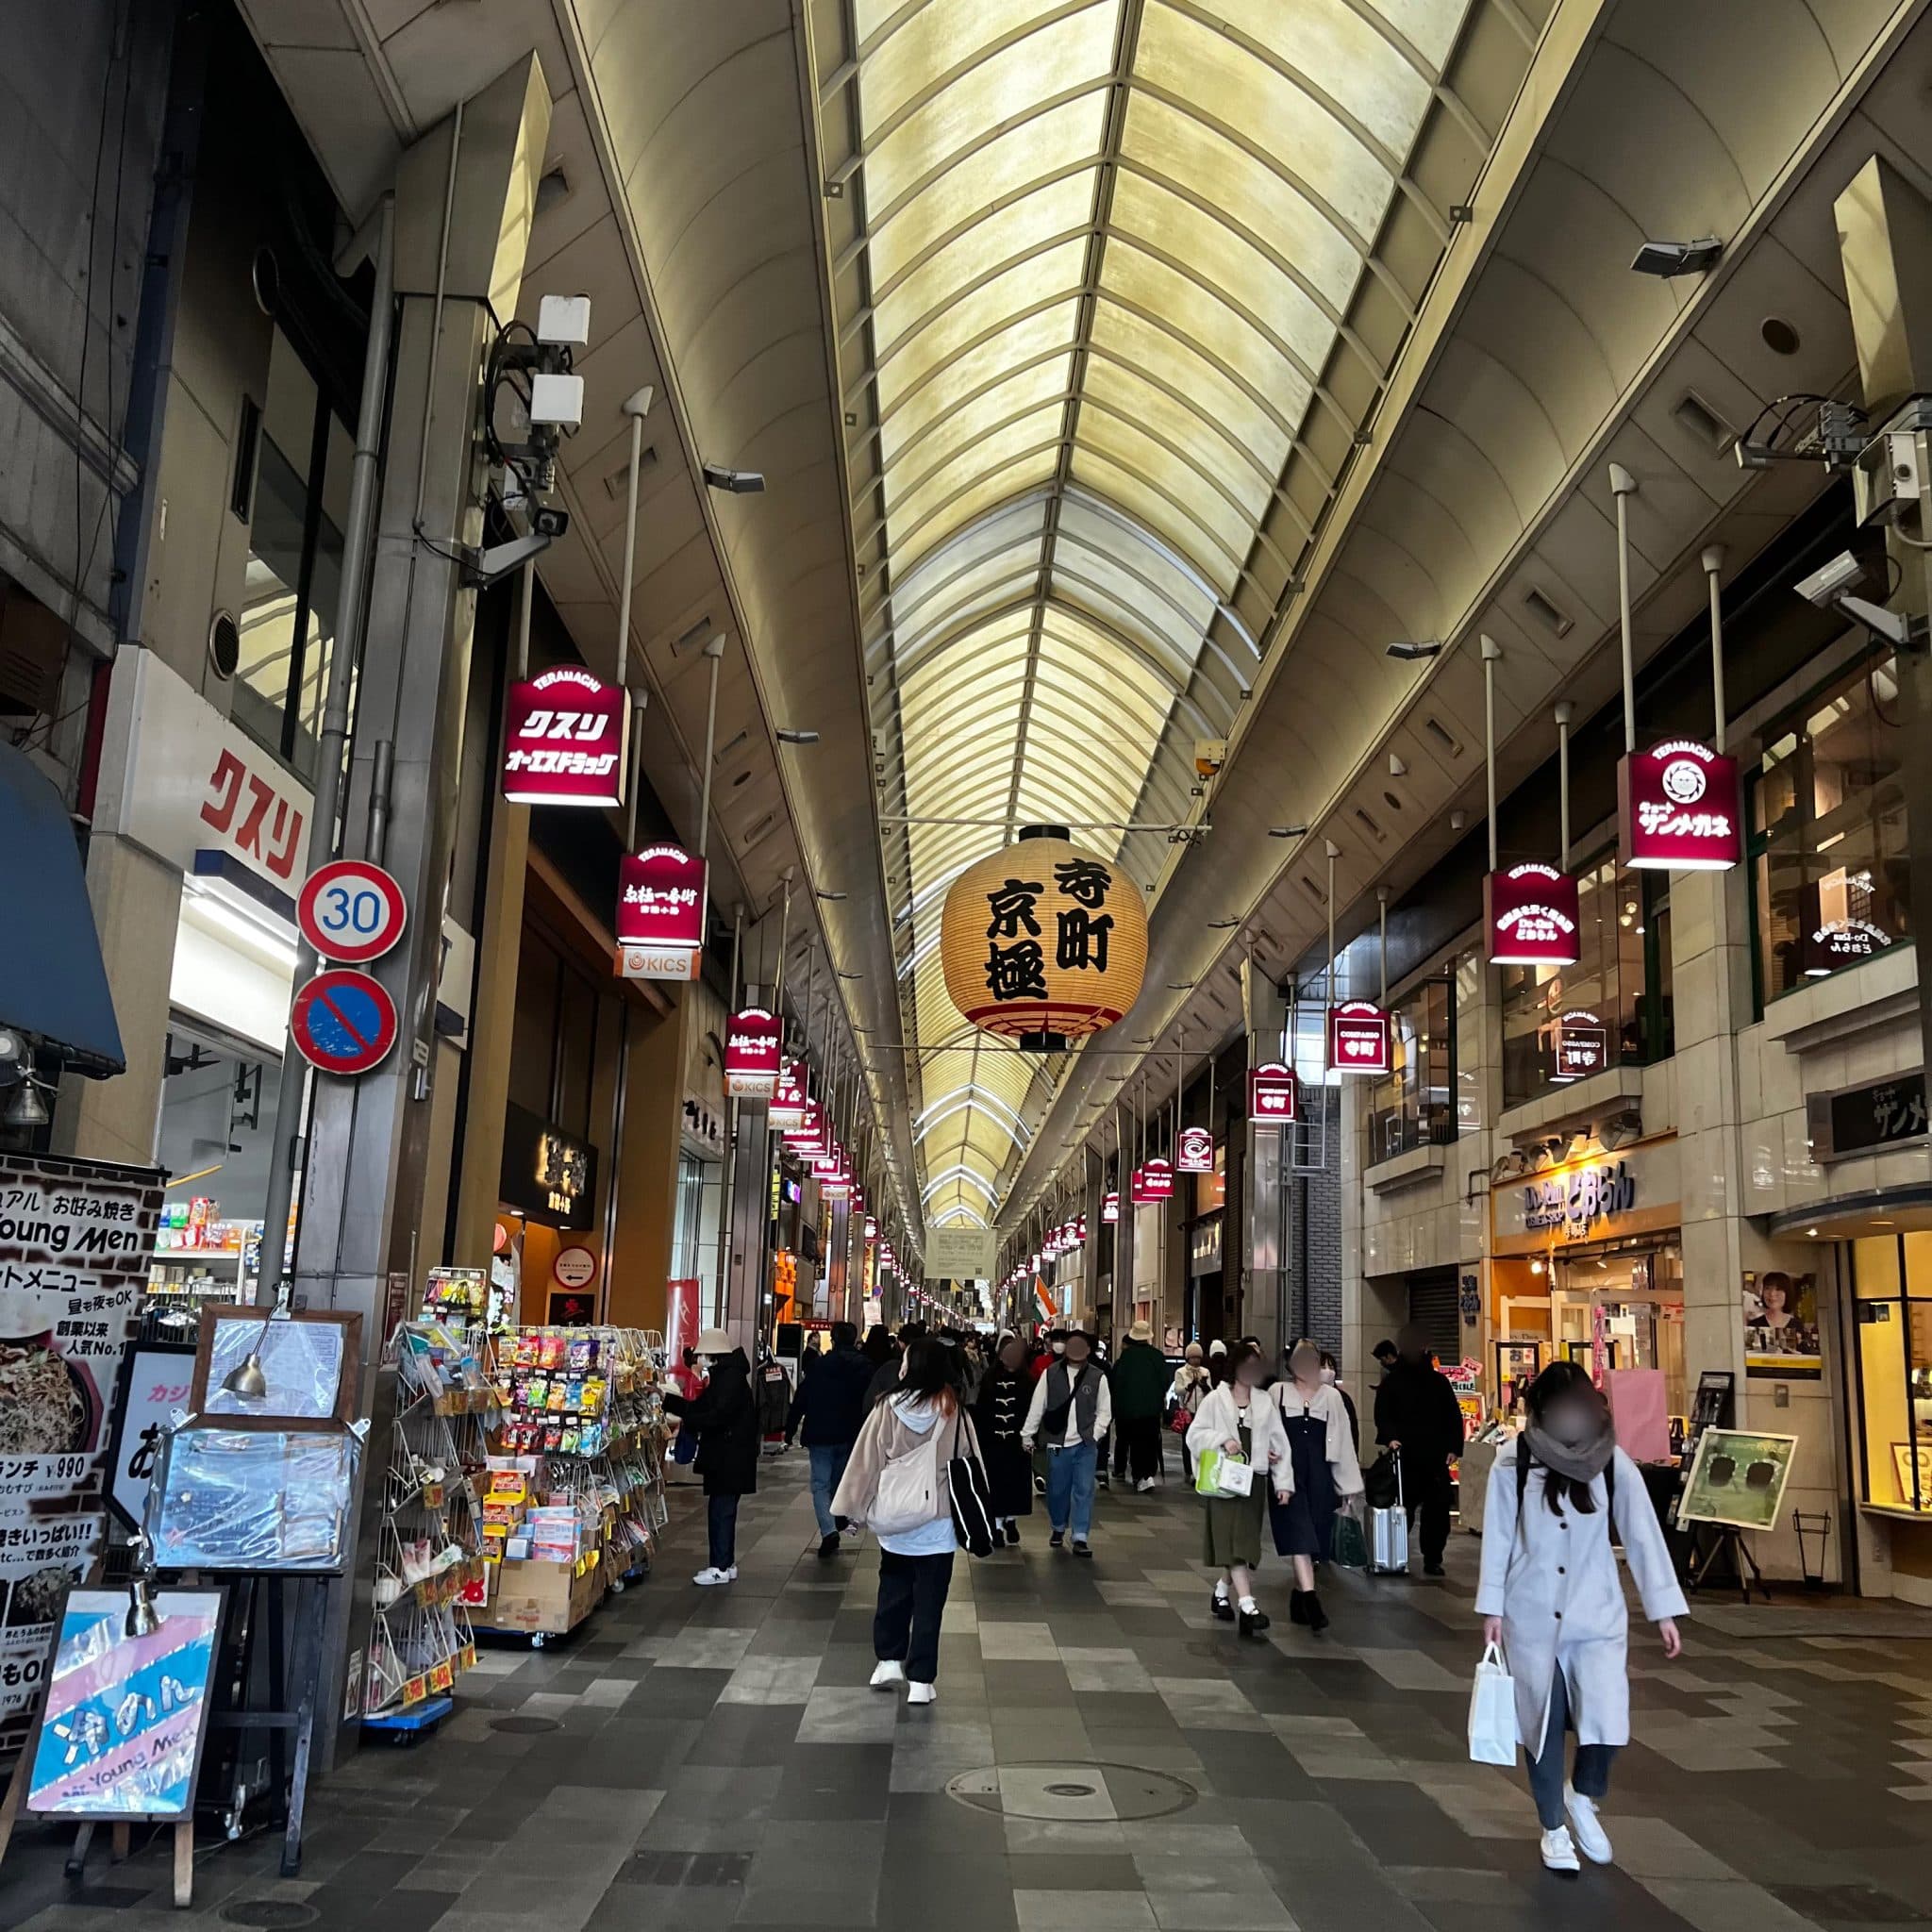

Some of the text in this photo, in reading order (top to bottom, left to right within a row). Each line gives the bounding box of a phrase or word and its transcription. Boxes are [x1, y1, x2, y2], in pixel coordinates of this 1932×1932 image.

[532, 670, 602, 693] TERAMACHI
[519, 710, 609, 741] クスリ
[505, 749, 619, 776] オーエスドラッグ
[1652, 741, 1715, 763] TERAMACHI
[200, 748, 304, 880] クスリ
[323, 888, 380, 934] 30
[1054, 858, 1114, 973] 寺町
[984, 878, 1048, 1001] 京極
[647, 958, 687, 973] KICS
[0, 1190, 136, 1222] アル お好み焼き
[0, 1213, 139, 1254] oung Men
[0, 1265, 97, 1292] トメニュー
[68, 1290, 133, 1316] 昼も夜もOK
[57, 1320, 109, 1338] 創業以来
[66, 1340, 126, 1357] 人気No.1
[147, 1383, 190, 1404] カジ
[89, 1751, 148, 1787] Young
